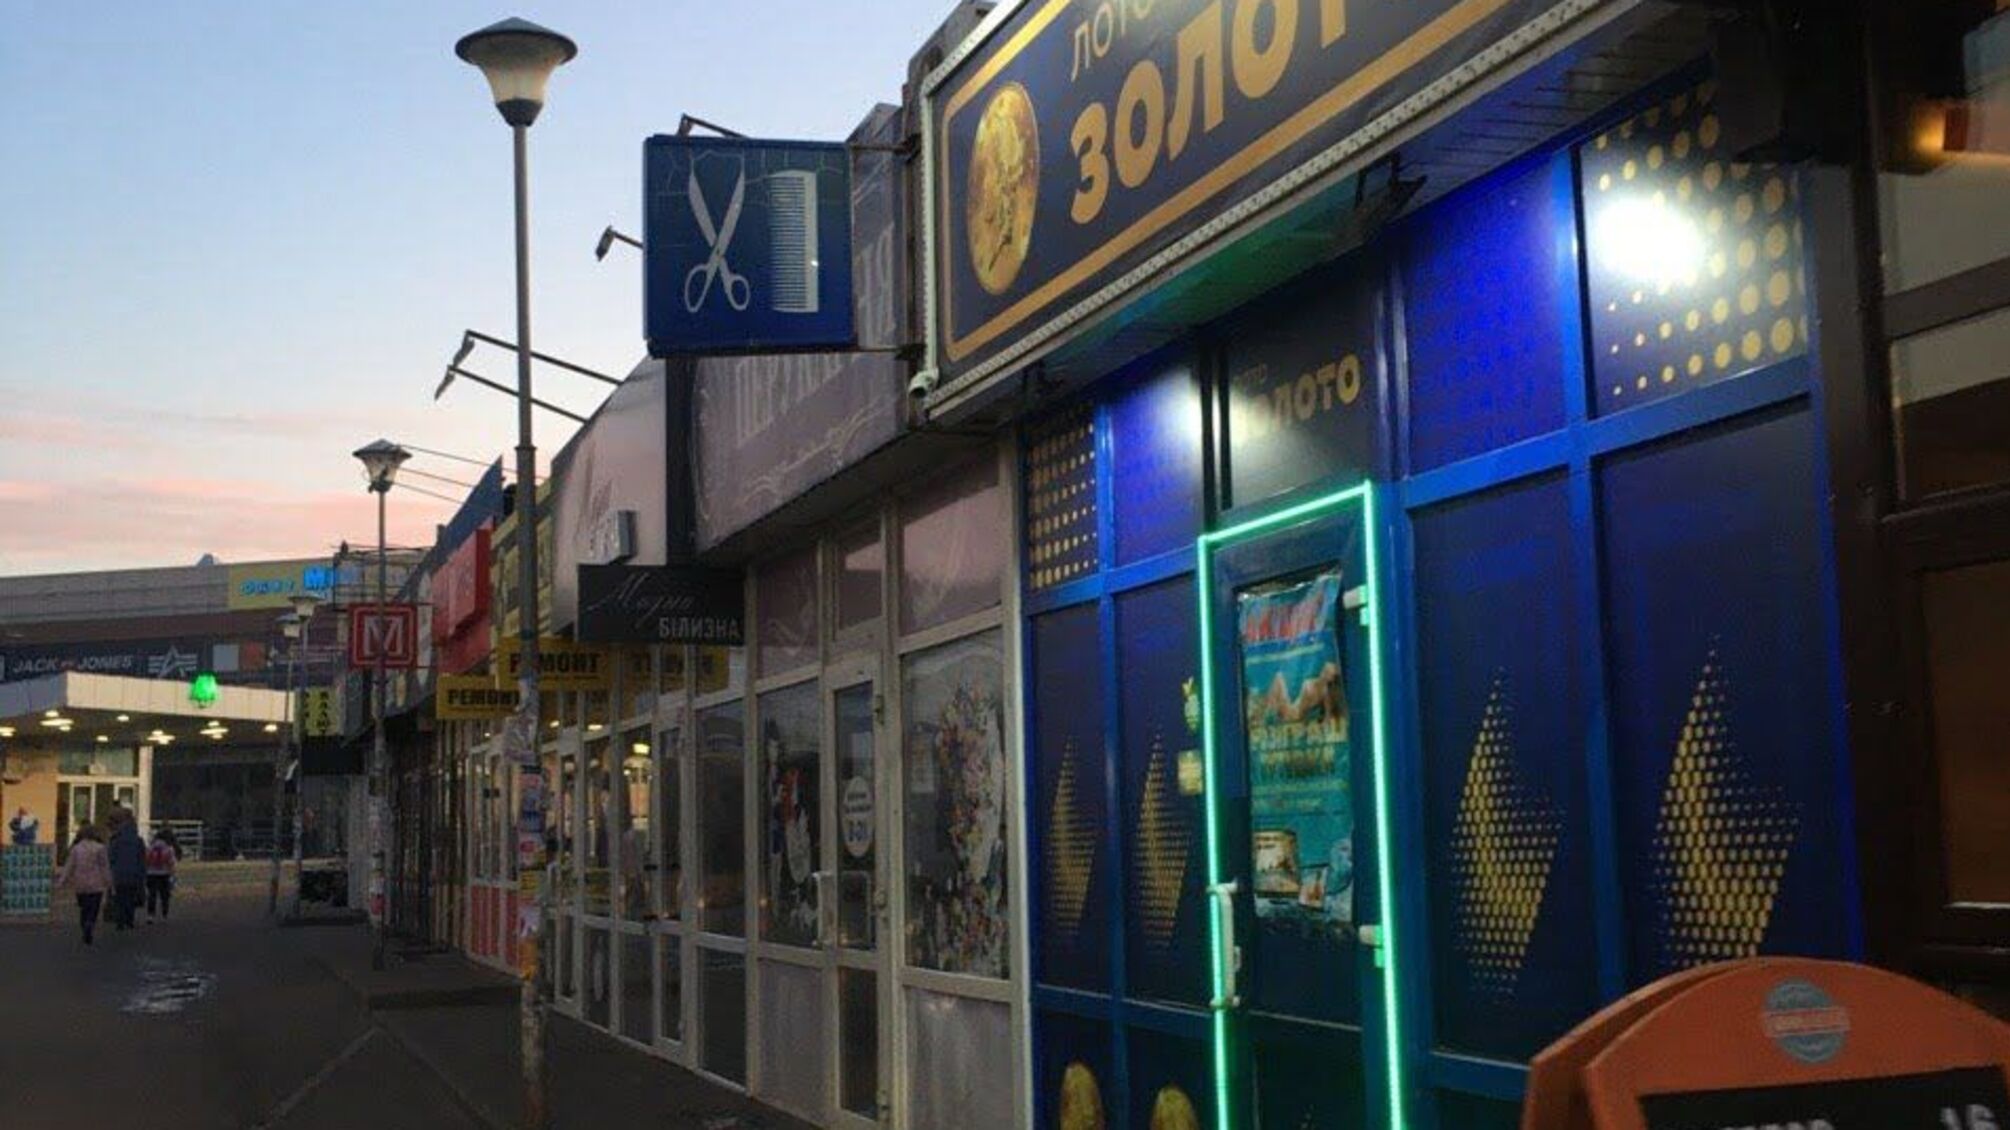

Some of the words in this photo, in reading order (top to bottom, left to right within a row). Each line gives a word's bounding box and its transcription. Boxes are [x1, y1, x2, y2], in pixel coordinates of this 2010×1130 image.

[658, 615, 741, 640] БІЛИЗНА
[13, 657, 58, 673] JACK
[77, 654, 134, 671] JONES
[509, 652, 600, 674] РМОНТ
